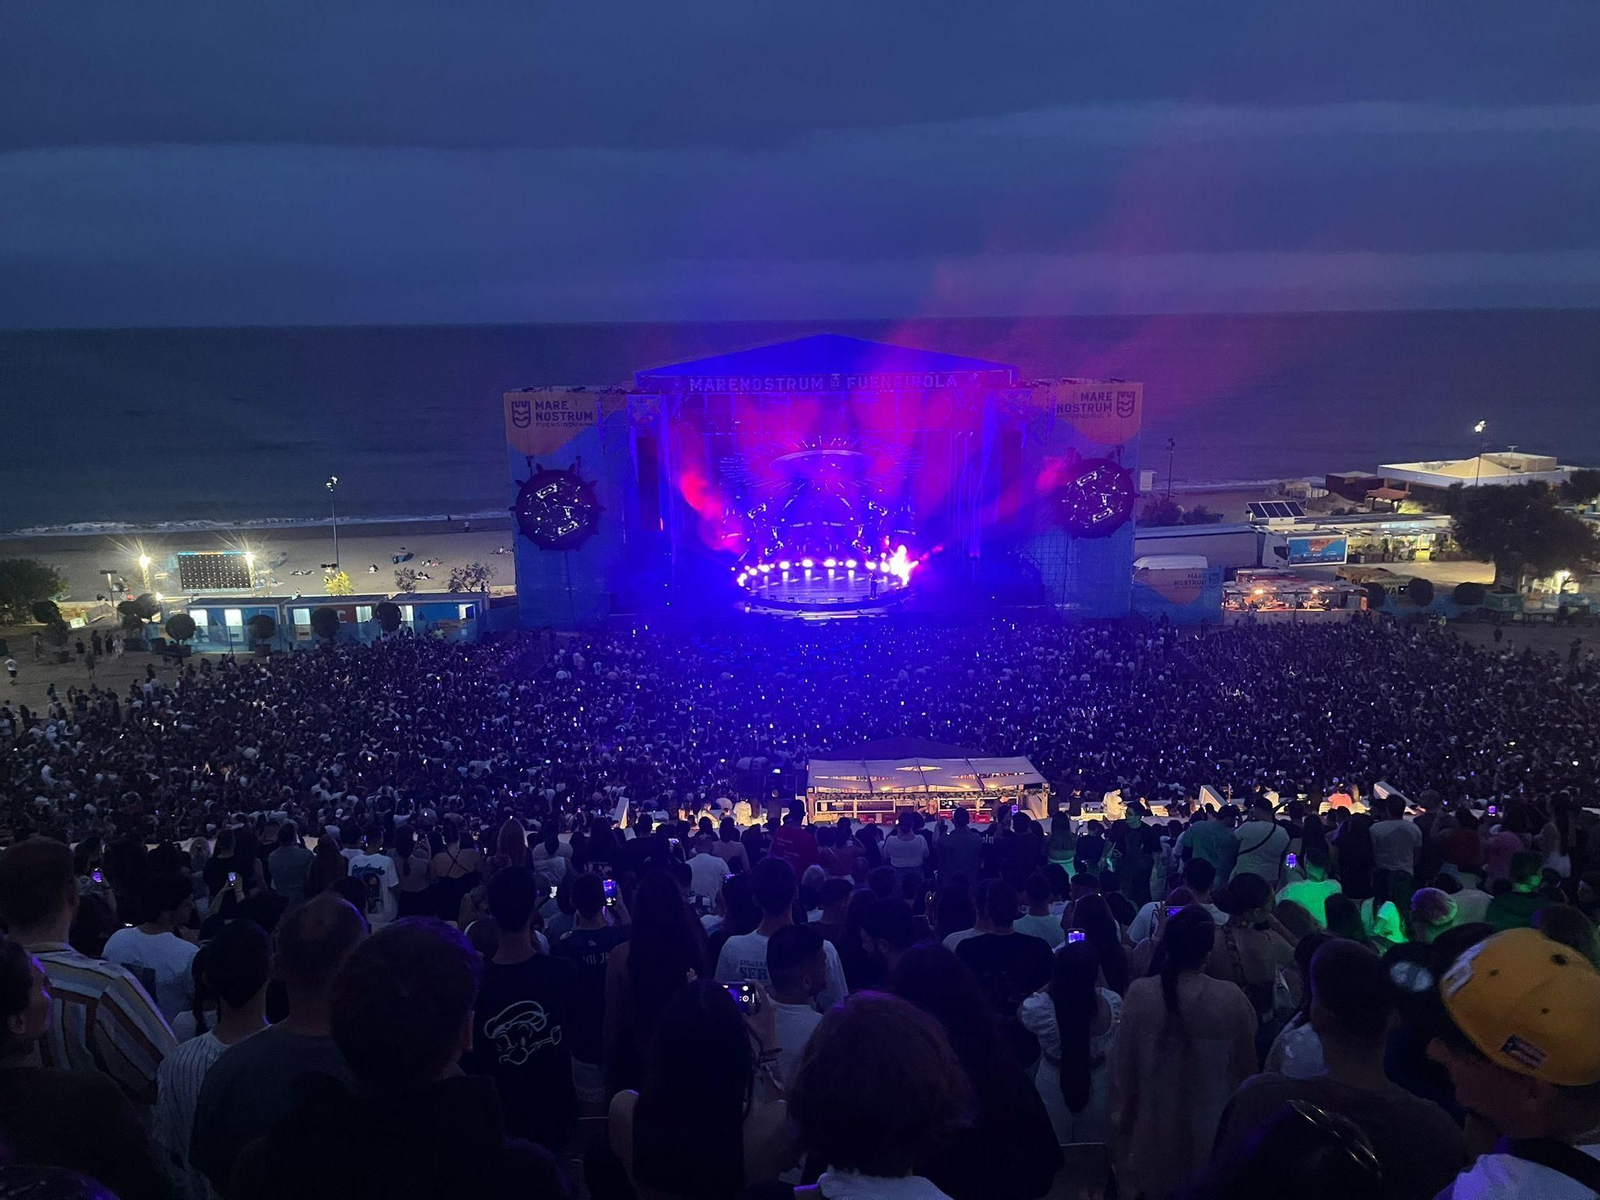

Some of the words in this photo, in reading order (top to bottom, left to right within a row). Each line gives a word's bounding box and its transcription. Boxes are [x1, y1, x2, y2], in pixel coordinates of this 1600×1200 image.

[689, 377, 824, 392] MARENOSTRUM
[1080, 391, 1113, 402] MARE
[535, 400, 569, 411] MARE
[1056, 402, 1112, 413] NOSTRUM
[535, 411, 593, 421] NOSTRUM
